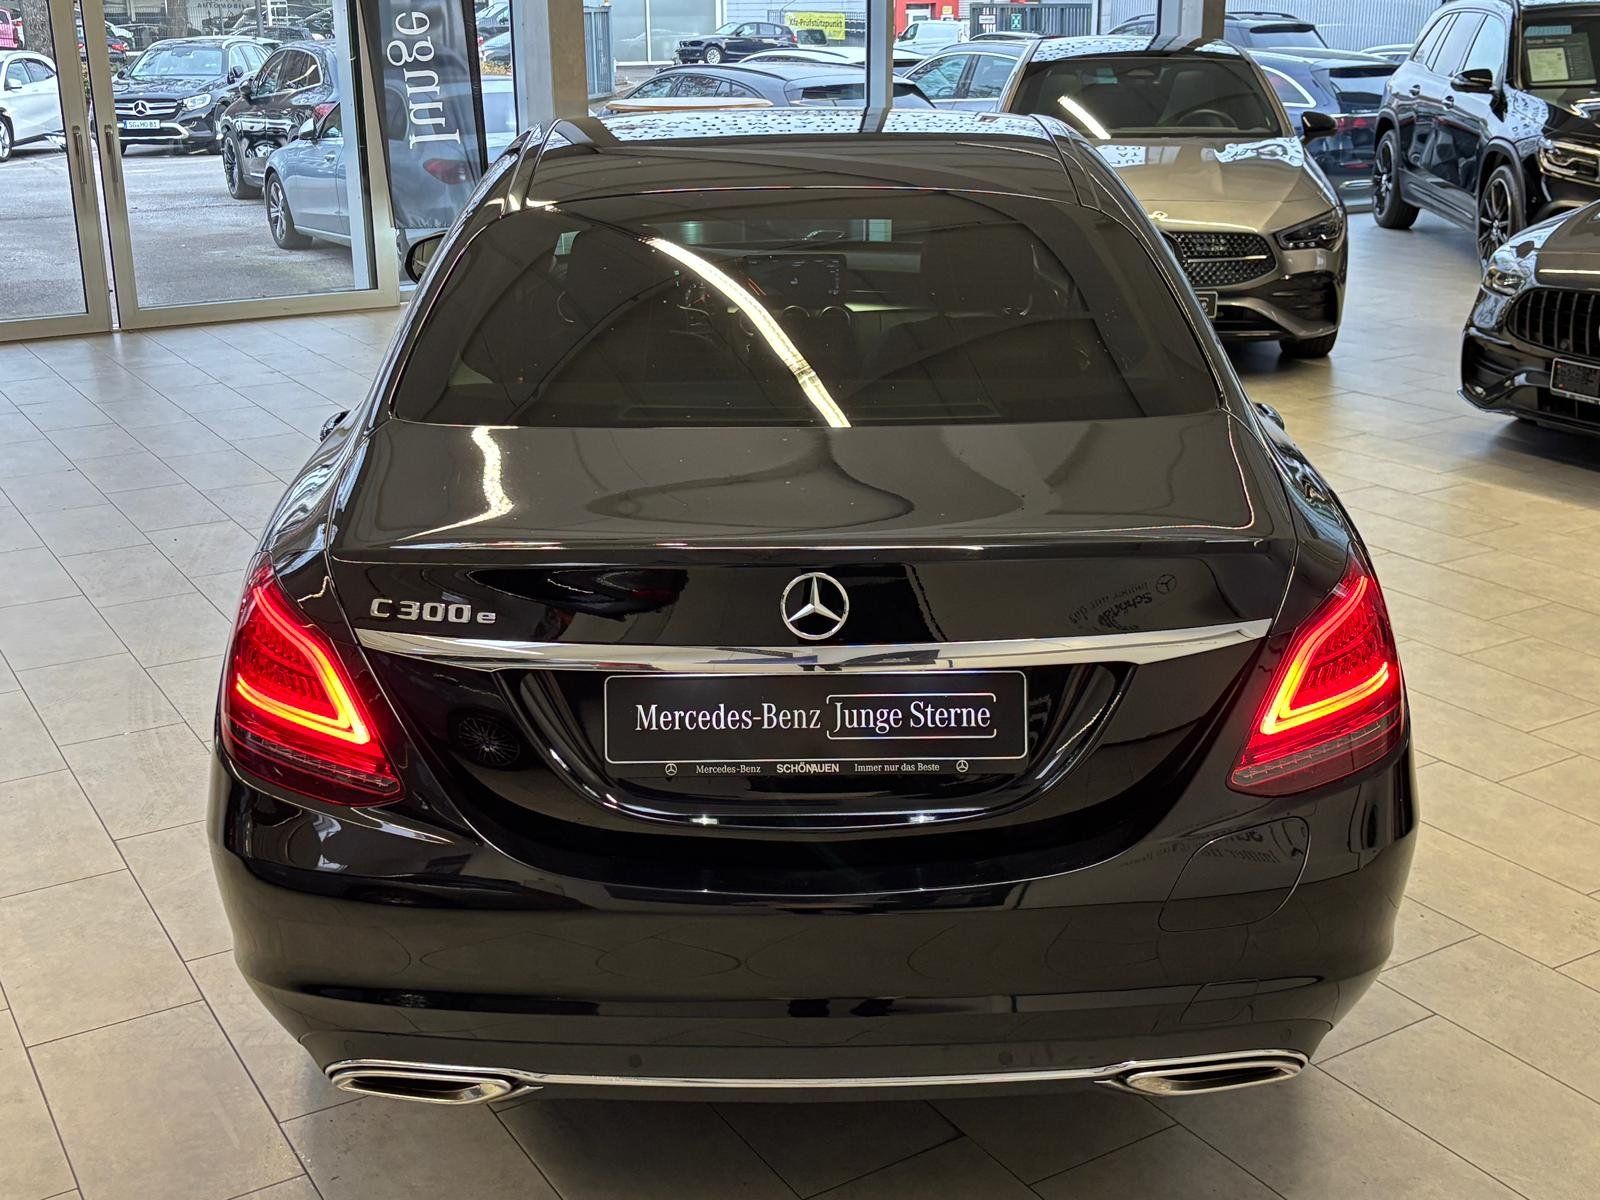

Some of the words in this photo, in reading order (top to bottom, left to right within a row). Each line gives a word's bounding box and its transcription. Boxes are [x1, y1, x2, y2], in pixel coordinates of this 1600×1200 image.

[369, 598, 393, 618] C
[396, 600, 472, 624] 300
[476, 612, 497, 624] e
[634, 703, 821, 731] Mercedes-Benz
[833, 702, 903, 734] Junge
[909, 700, 991, 728] Sterne
[695, 764, 762, 775] Mercedes-Benz
[776, 762, 840, 775] SCHÖNAUEN
[854, 763, 882, 773] Immer
[884, 764, 899, 773] nur
[901, 762, 916, 772] das
[917, 762, 940, 772] Beste
